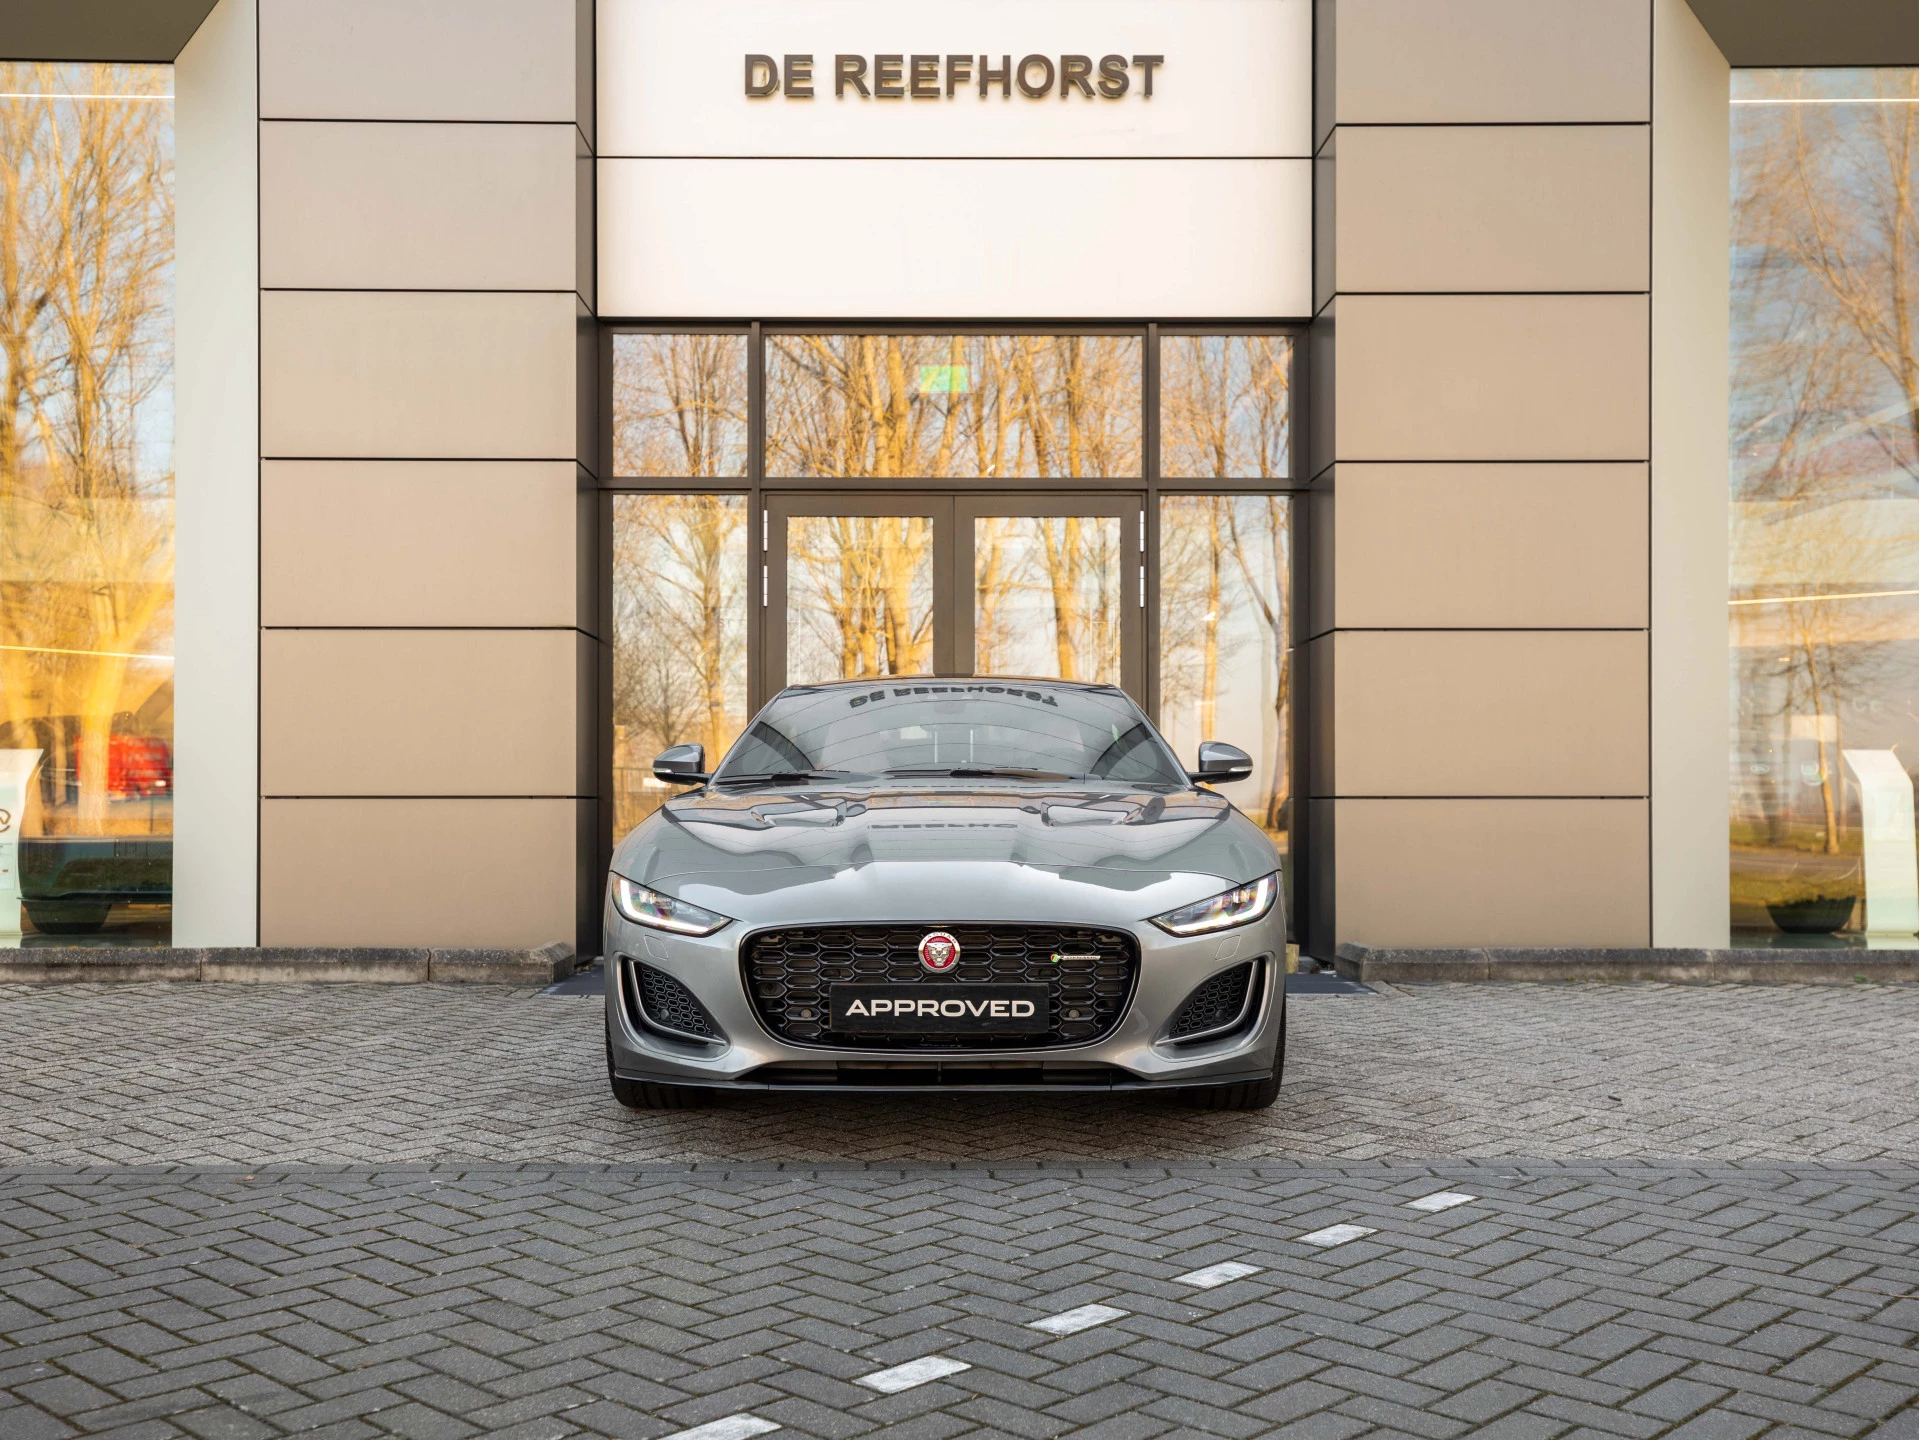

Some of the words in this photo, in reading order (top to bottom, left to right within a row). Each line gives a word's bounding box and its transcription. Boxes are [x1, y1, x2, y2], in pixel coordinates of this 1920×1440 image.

[744, 54, 815, 98] DE
[834, 54, 1165, 98] REEFHORST
[845, 999, 1035, 1017] APPROVED
